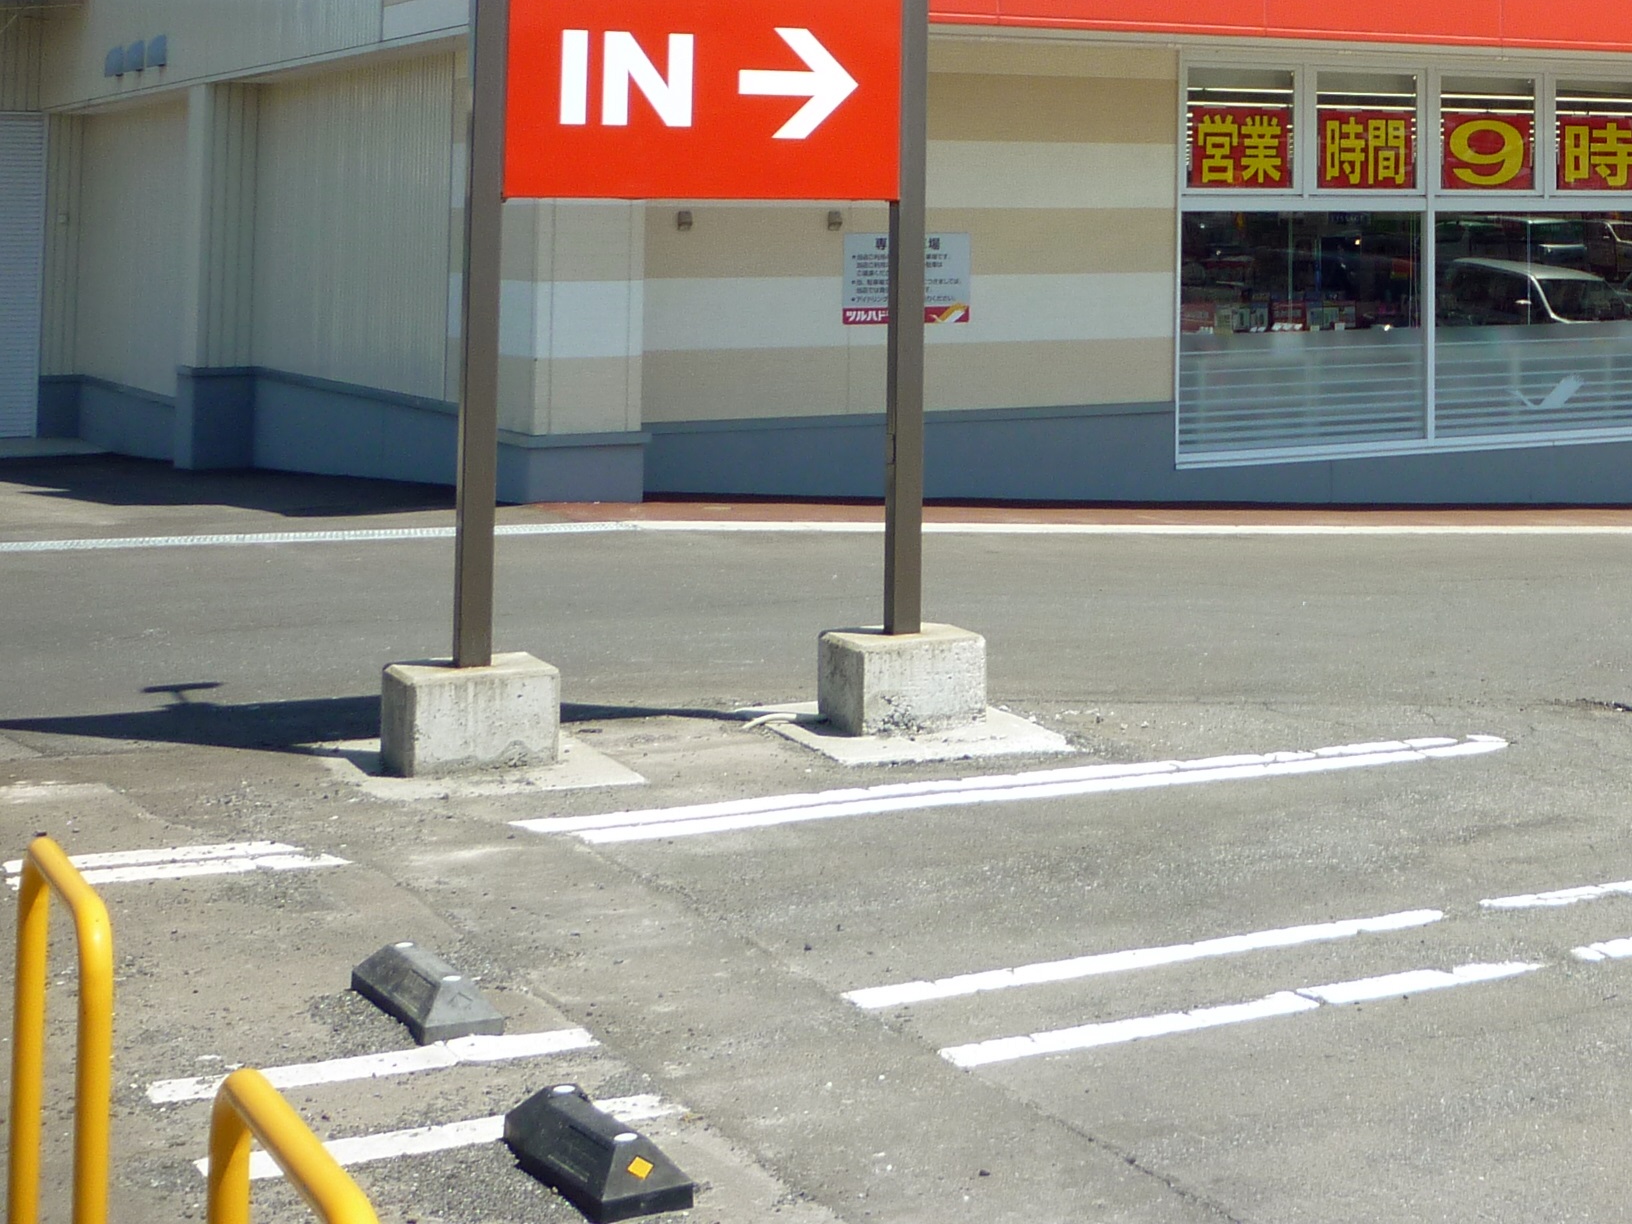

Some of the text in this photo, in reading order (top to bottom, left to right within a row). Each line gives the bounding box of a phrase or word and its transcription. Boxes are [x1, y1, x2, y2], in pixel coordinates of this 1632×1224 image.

[559, 29, 694, 127] IN
[846, 310, 888, 322] ツルハド
